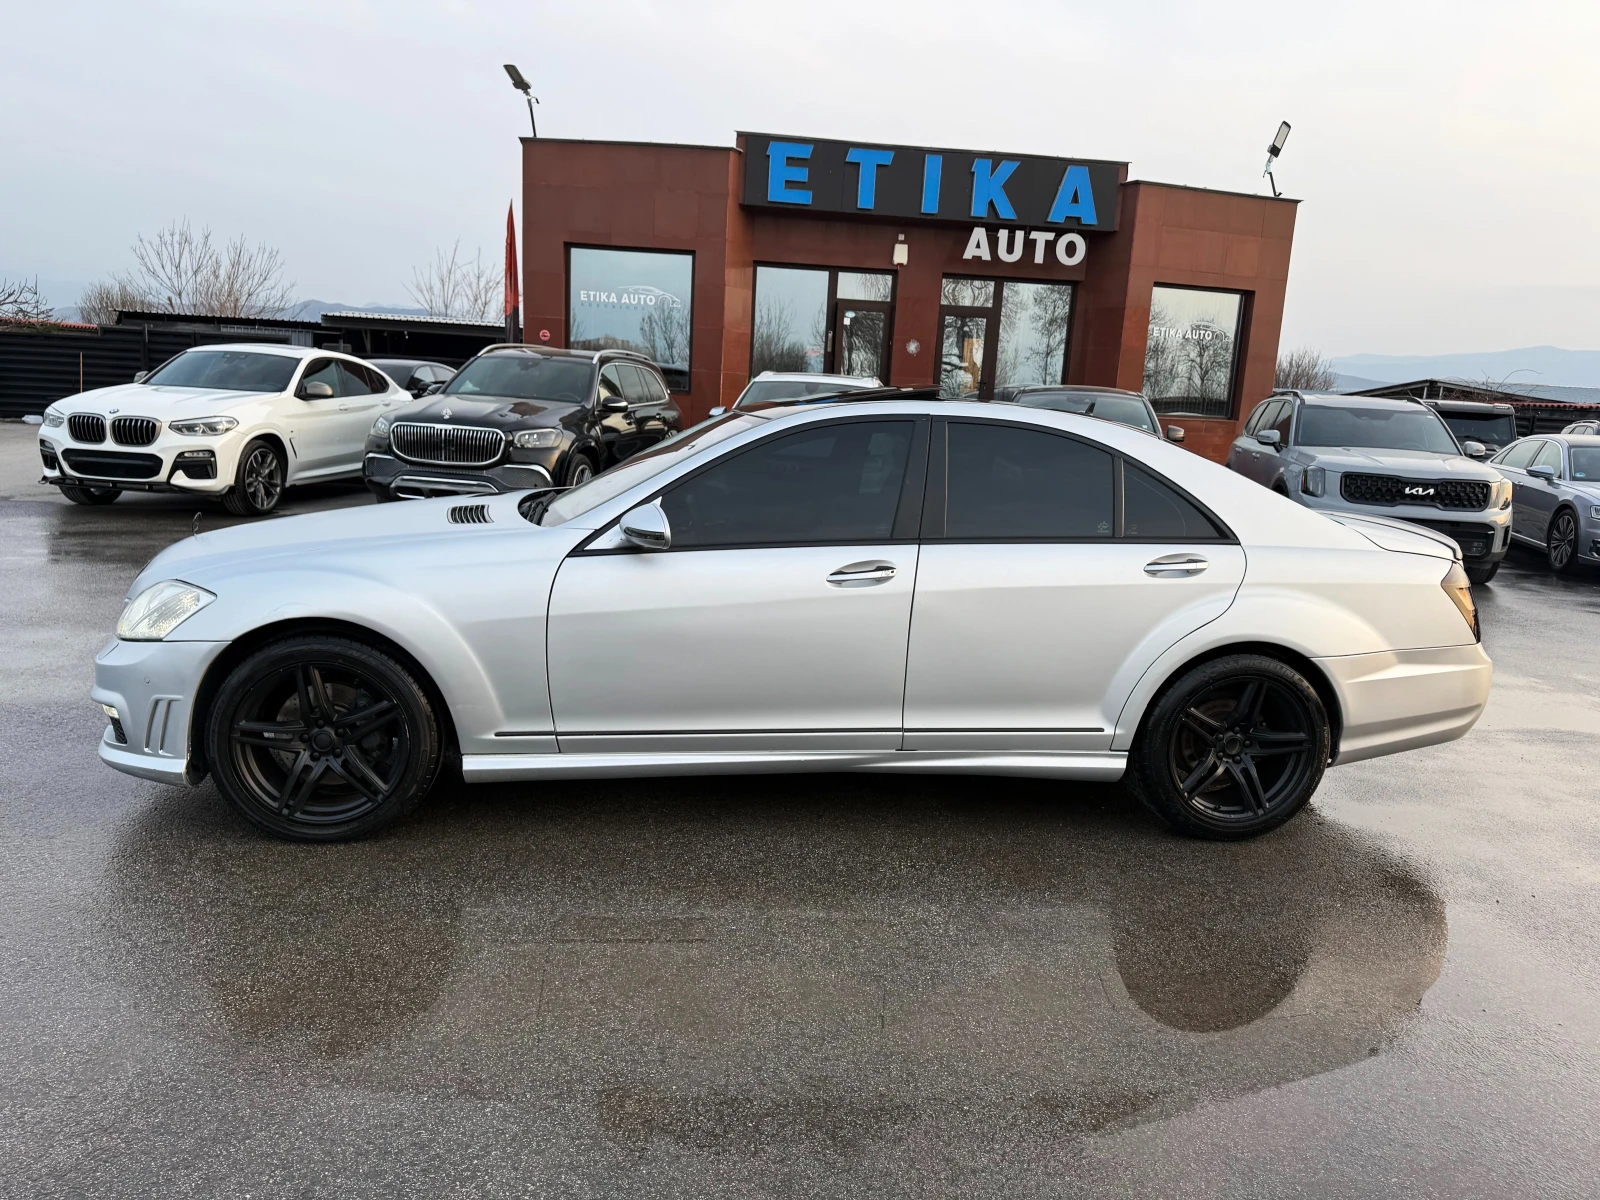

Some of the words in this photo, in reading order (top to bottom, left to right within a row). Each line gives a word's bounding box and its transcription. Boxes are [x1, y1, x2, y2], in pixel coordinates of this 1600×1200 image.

[766, 140, 1098, 225] ETIKA
[962, 226, 1087, 266] AUTO
[580, 290, 617, 303] ETIKA
[621, 293, 656, 306] AUTO
[1153, 326, 1182, 339] ETIKA
[1184, 329, 1213, 340] AUTO
